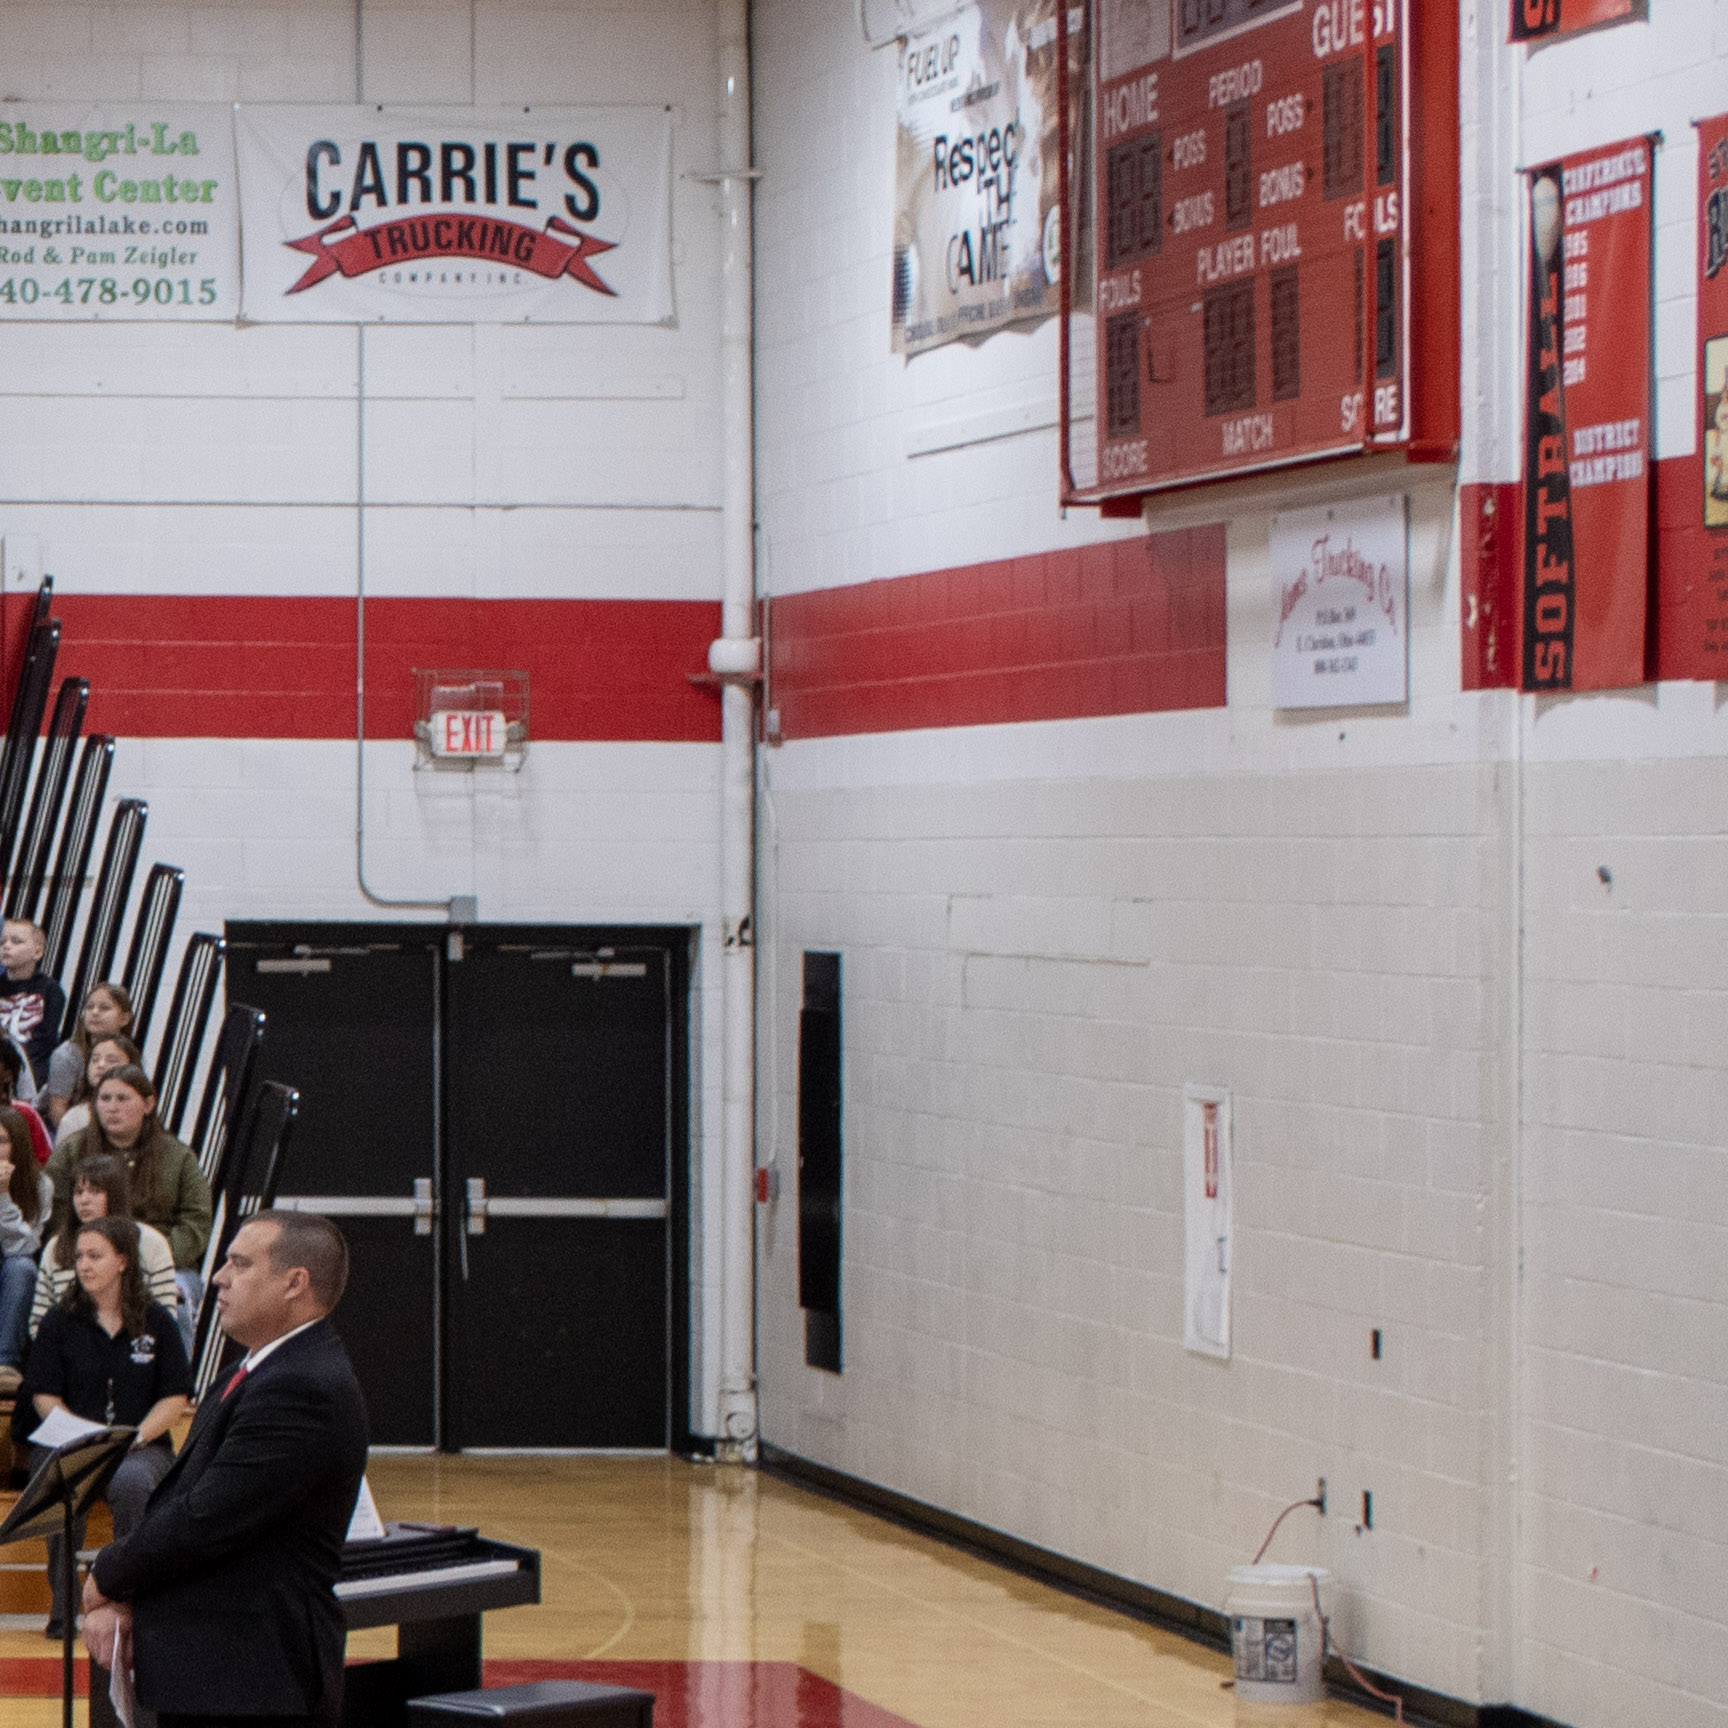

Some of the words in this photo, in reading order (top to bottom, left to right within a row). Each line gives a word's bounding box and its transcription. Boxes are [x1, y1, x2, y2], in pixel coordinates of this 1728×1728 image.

[1103, 72, 1159, 138] HOME
[1208, 59, 1263, 109] PERIOD
[1266, 93, 1304, 137] POSS
[1173, 129, 1206, 171] POSS
[93, 170, 218, 203] Center
[306, 139, 601, 222] CARRIE'S
[1259, 161, 1304, 207] BONUS
[1173, 191, 1214, 234] BONUS
[43, 247, 62, 265] &
[70, 247, 116, 265] Pam
[124, 246, 198, 268] Zeigler
[362, 219, 537, 264] TRUCKING
[1198, 234, 1255, 284] PLAYER
[1260, 223, 1301, 265] FOUL
[1100, 270, 1141, 312] FOULS
[1222, 413, 1273, 456] MATCH
[1104, 440, 1148, 478] SCORE
[446, 714, 494, 753] EXIT
